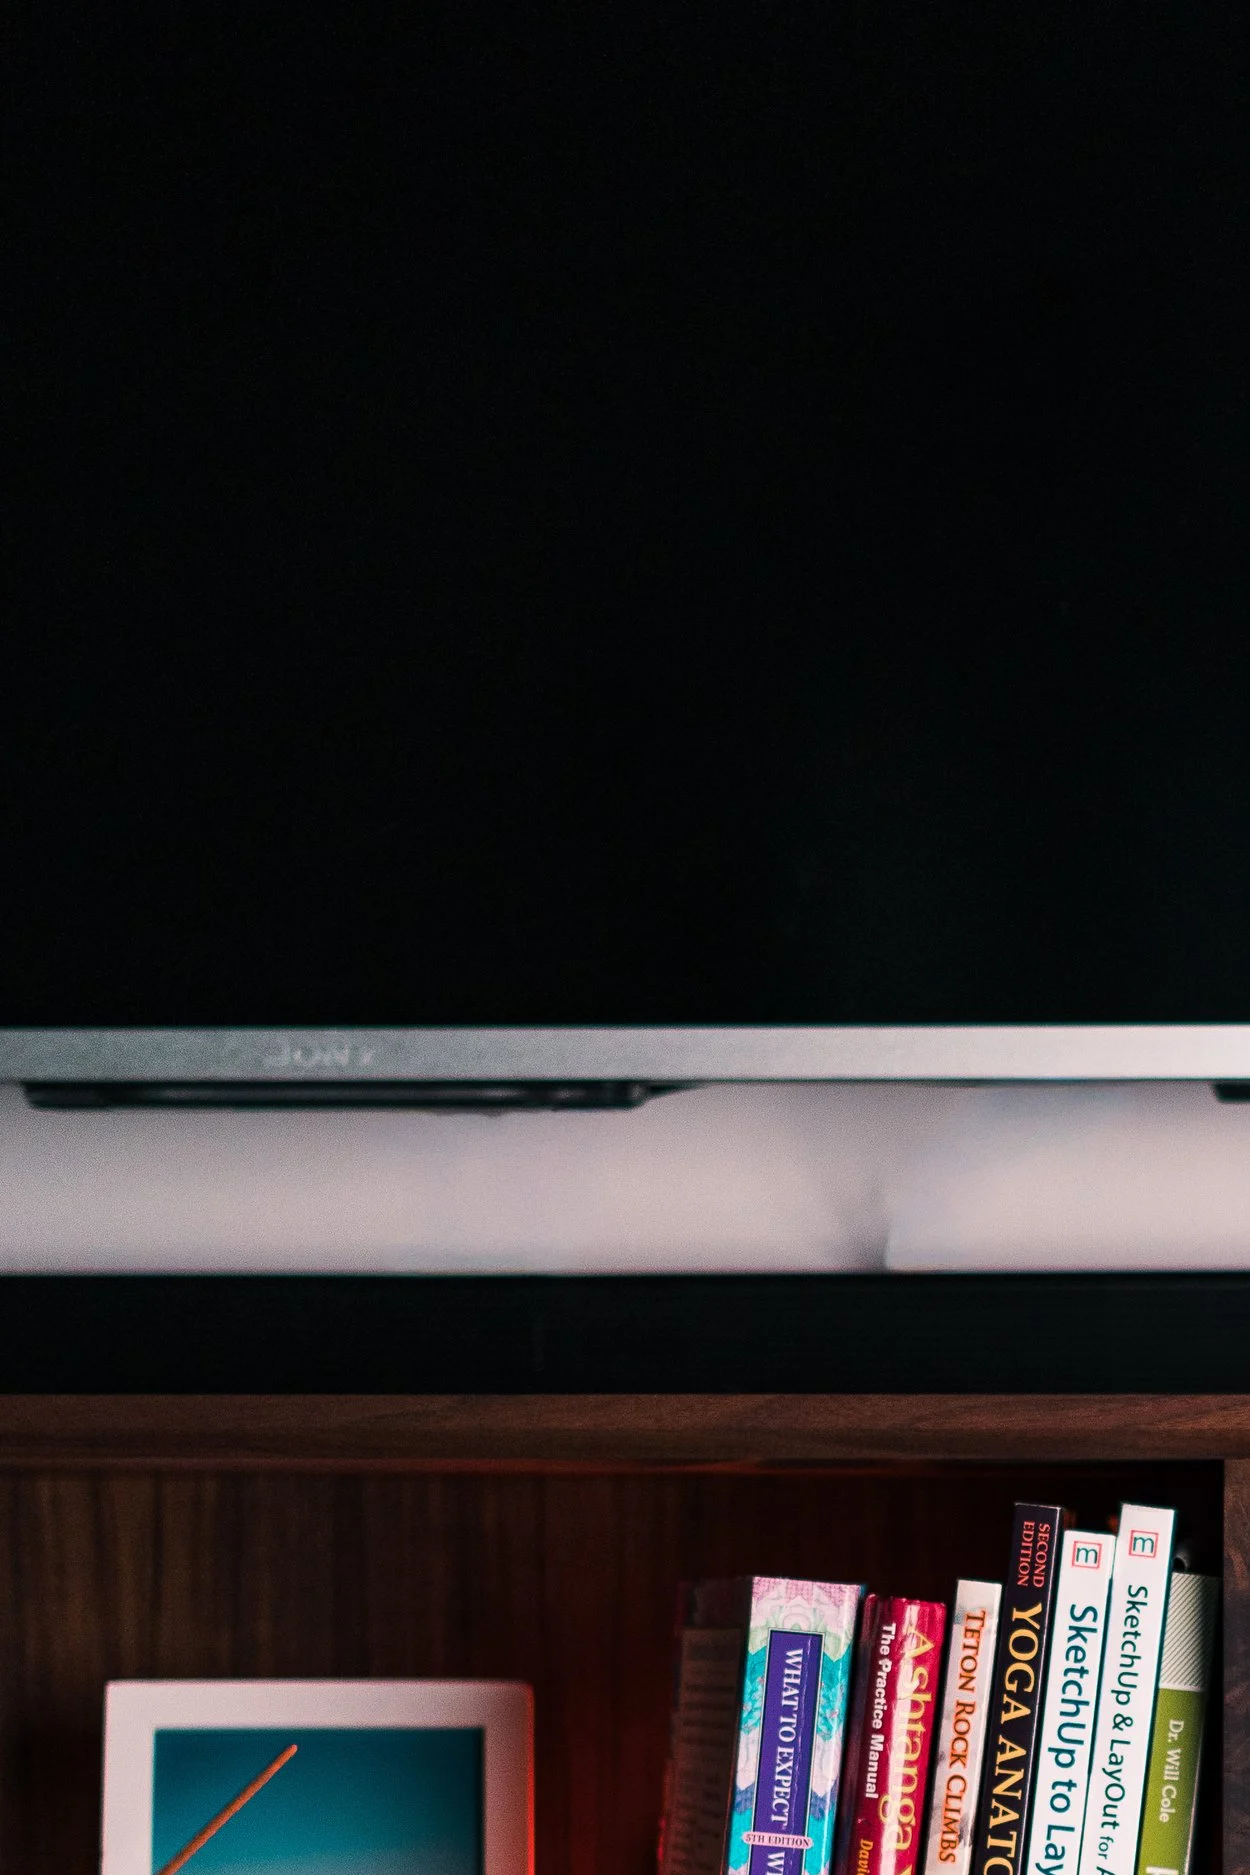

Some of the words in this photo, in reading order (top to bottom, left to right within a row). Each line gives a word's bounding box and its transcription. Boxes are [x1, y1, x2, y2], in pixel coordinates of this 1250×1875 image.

[1017, 1521, 1034, 1586] EDITION
[1033, 1523, 1050, 1587] SECOND
[880, 1623, 896, 1655] The
[958, 1610, 986, 1691] TETON
[1000, 1602, 1043, 1724] YOGA
[1111, 1585, 1149, 1705] SketchUp
[781, 1648, 803, 1711] WHAT
[872, 1659, 892, 1729] Practice
[1048, 1604, 1099, 1769] SketchUp
[779, 1714, 797, 1742] TO
[878, 1625, 935, 1851] Ashtanga
[949, 1701, 975, 1769] ROCK
[1112, 1713, 1133, 1731] &
[1168, 1719, 1184, 1743] Dr.
[771, 1746, 794, 1826] EXPECT
[865, 1735, 884, 1798] Manual
[1102, 1740, 1131, 1830] LayOut
[1164, 1748, 1181, 1780] Will
[938, 1775, 968, 1863] CLIMBS
[1050, 1780, 1077, 1813] to
[1160, 1785, 1177, 1822] Cole
[745, 1833, 764, 1844] 5TH
[768, 1835, 810, 1847] EDITION
[1098, 1836, 1114, 1860] for
